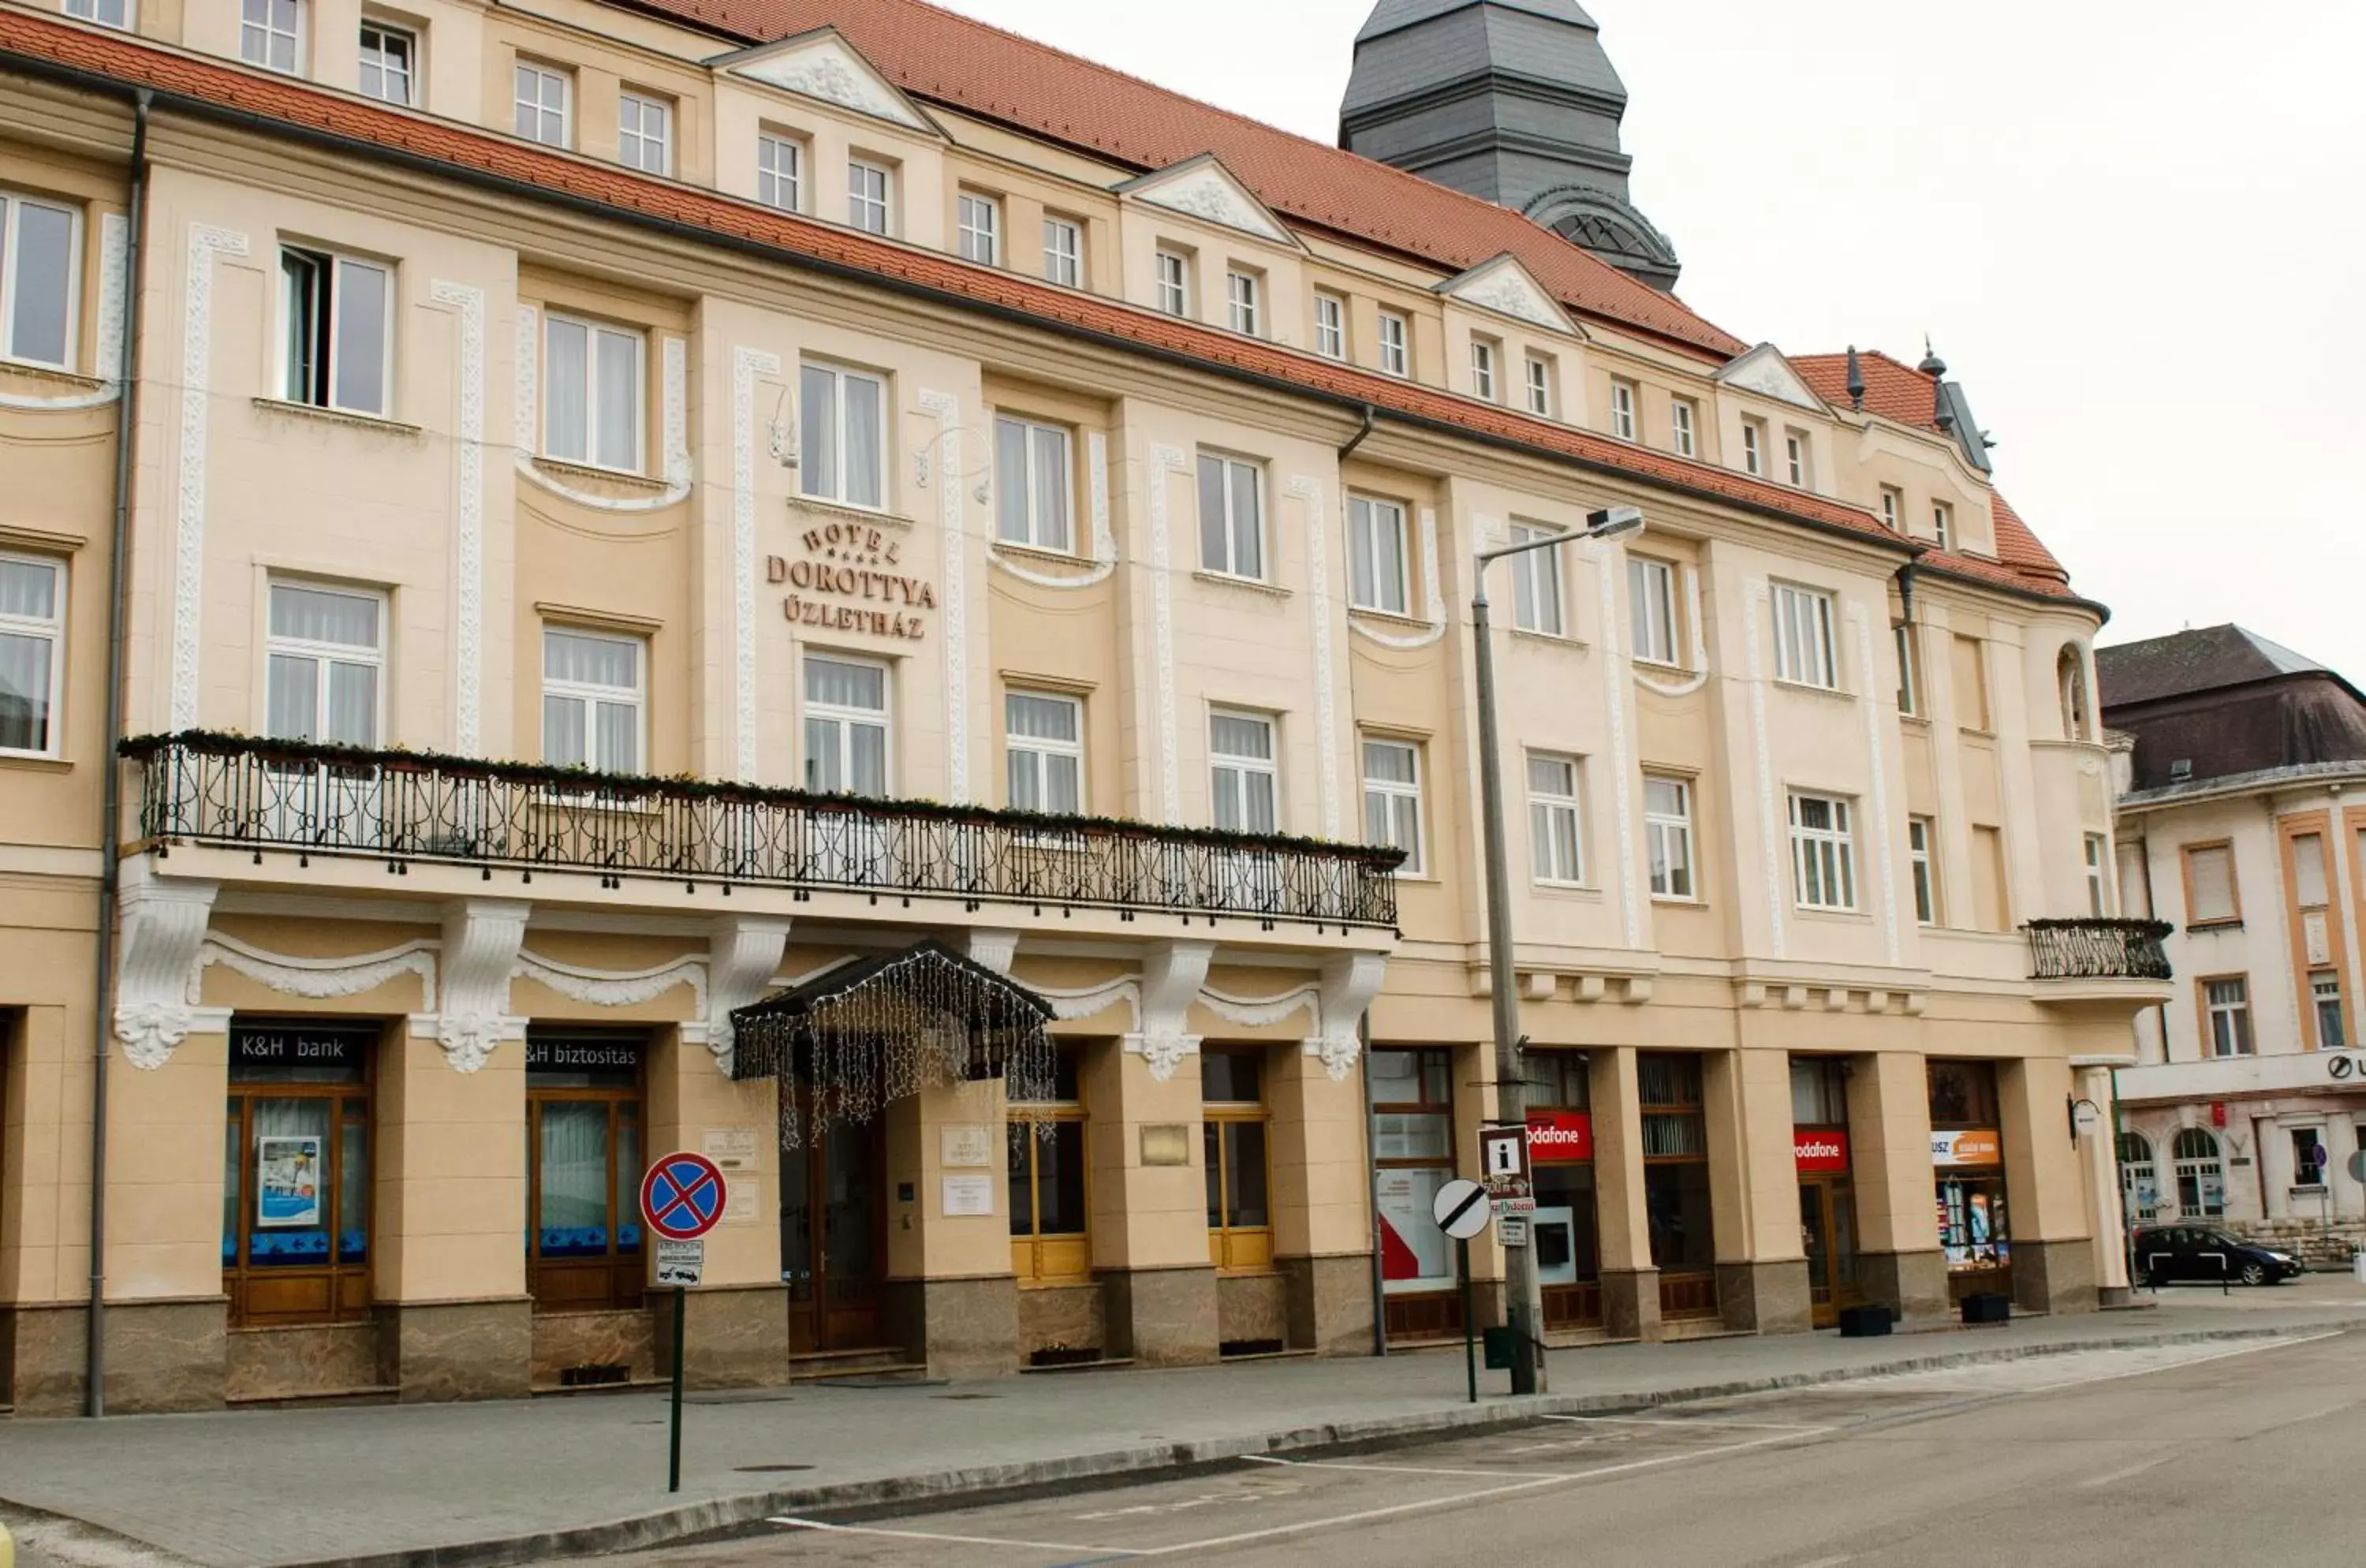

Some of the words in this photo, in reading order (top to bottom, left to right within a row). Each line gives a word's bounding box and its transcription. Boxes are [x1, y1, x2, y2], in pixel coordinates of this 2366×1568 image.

[802, 523, 900, 565] HOTEL
[767, 554, 936, 610] DOROTTYA
[242, 1036, 284, 1056] K&H
[297, 1036, 344, 1058] bank
[526, 1043, 548, 1062] &H
[1526, 1126, 1578, 1144] odafone
[1931, 1141, 1949, 1152] USZ
